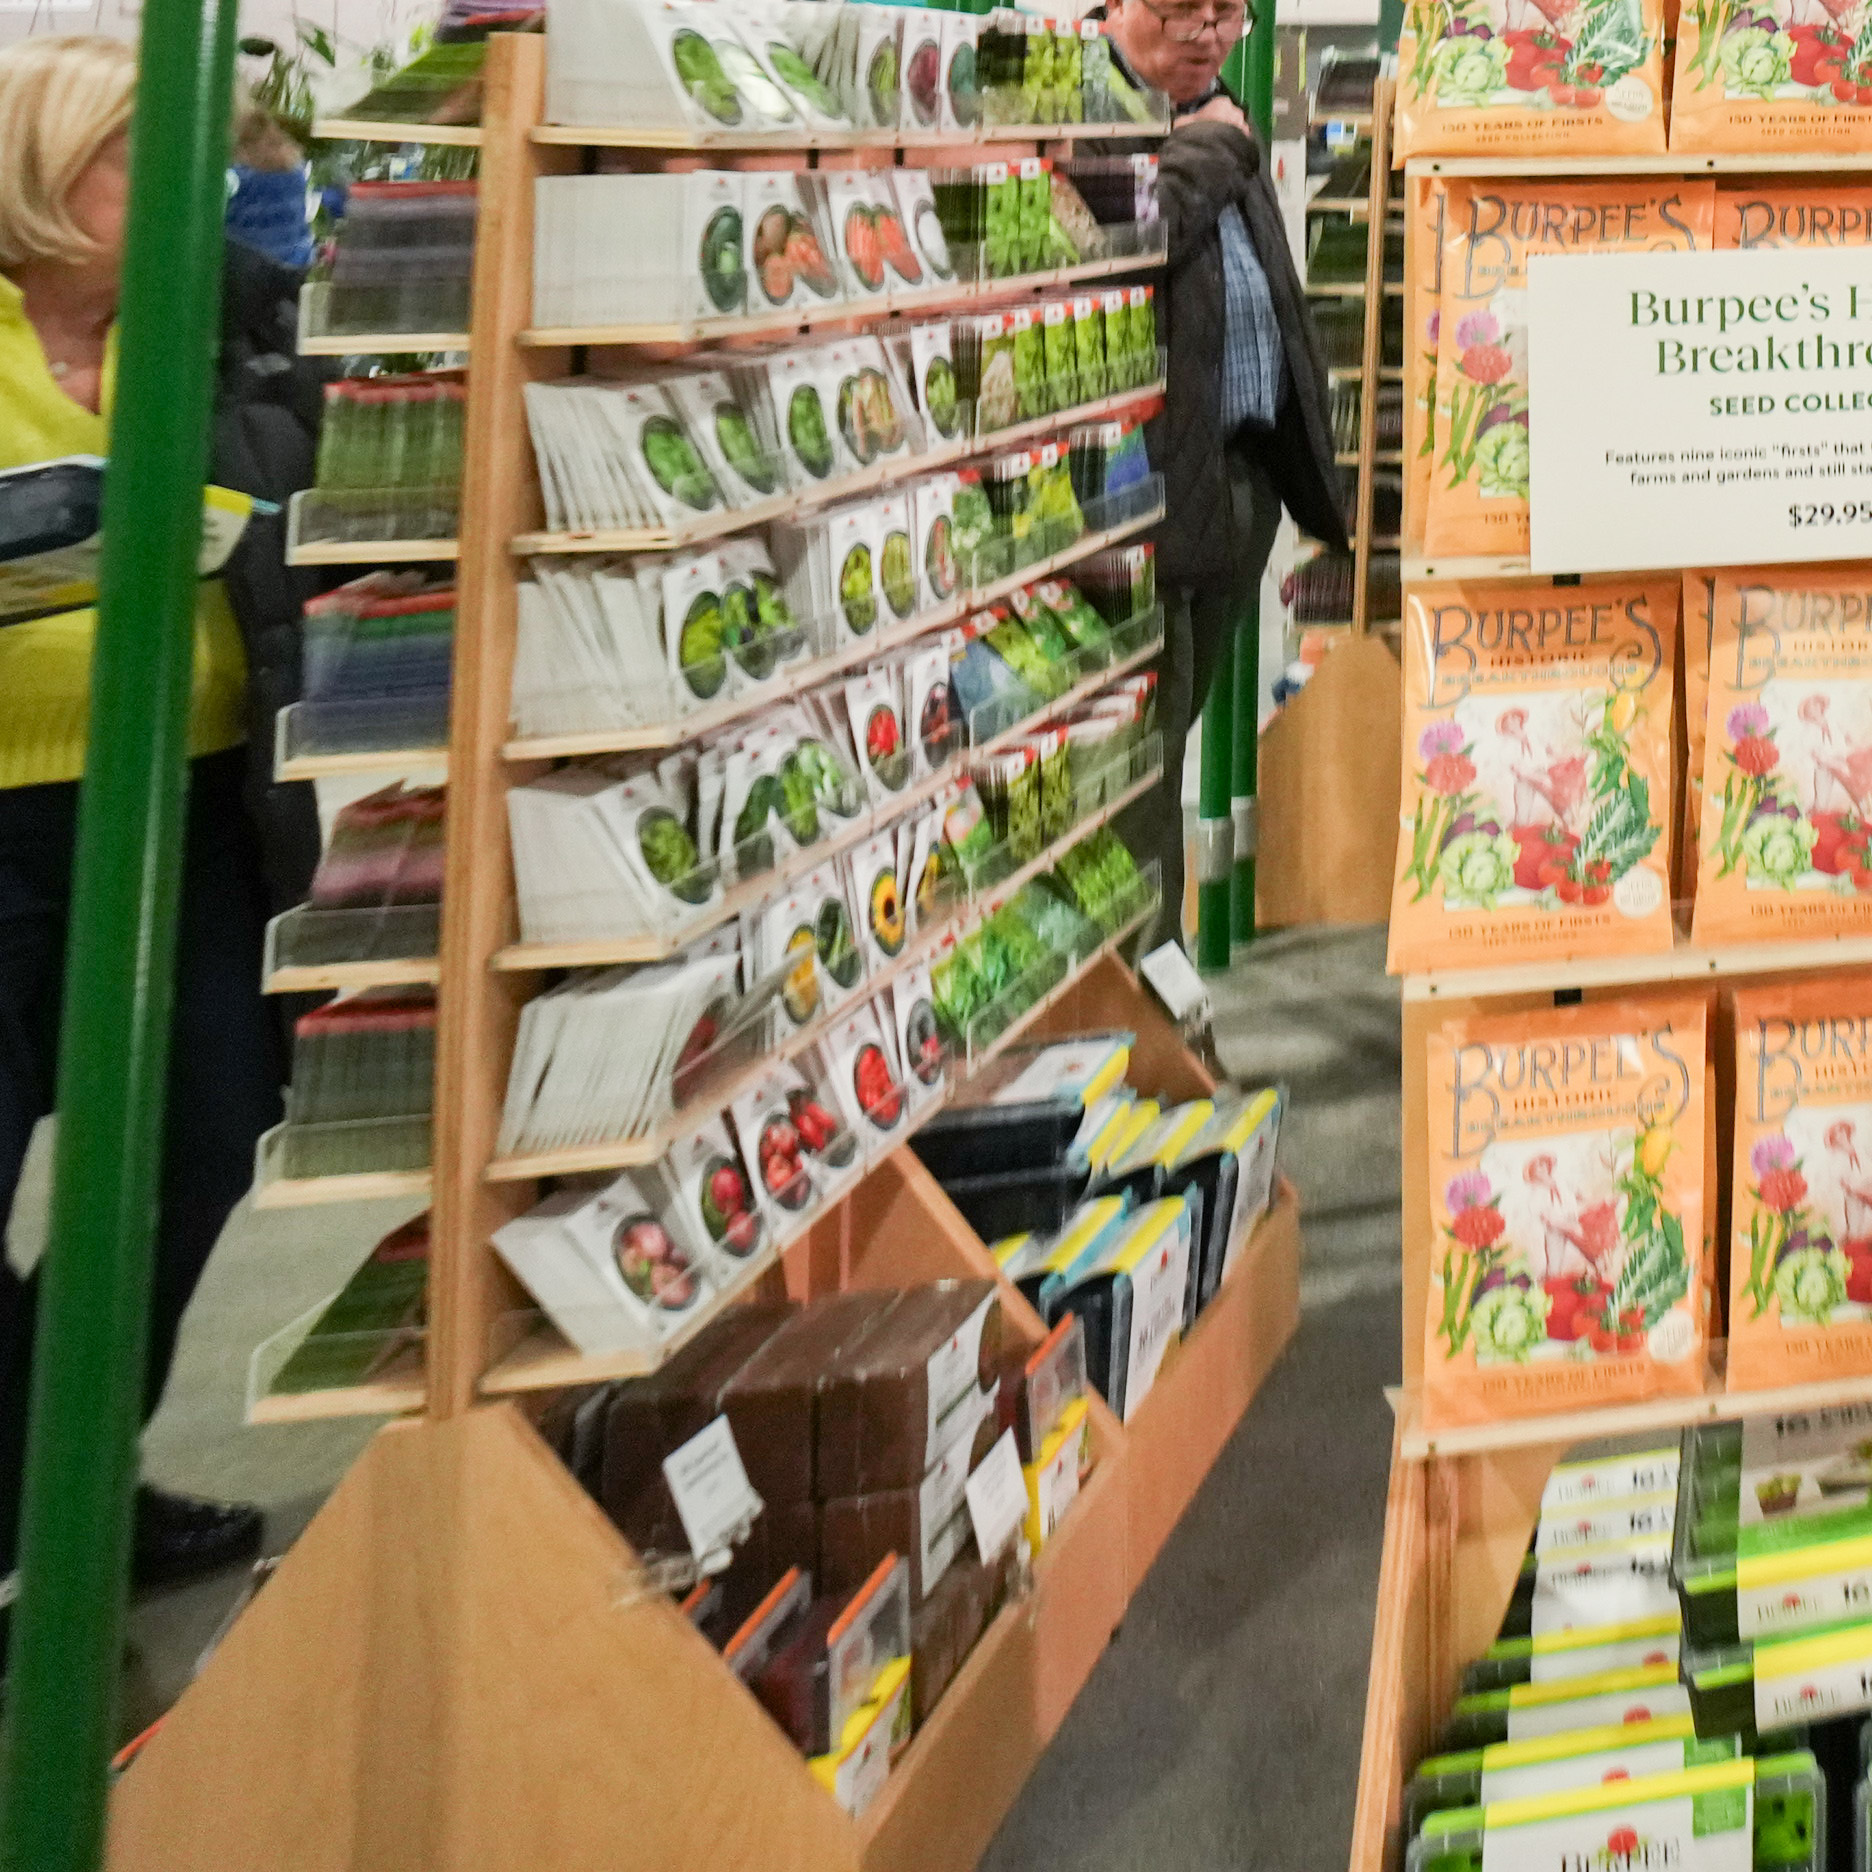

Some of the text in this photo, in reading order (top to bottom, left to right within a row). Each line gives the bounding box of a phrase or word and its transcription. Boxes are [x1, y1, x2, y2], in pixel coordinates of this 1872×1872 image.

[1759, 114, 1806, 125] YEARS
[1454, 193, 1697, 300] BURPEE'S
[1629, 281, 1831, 333] Burpee's
[1709, 395, 1776, 417] SEED
[1605, 449, 1675, 467] Features
[1680, 446, 1714, 463] nine
[1720, 444, 1767, 461] iconic
[1833, 440, 1865, 456] that
[1630, 471, 1676, 487] farms
[1681, 468, 1711, 484] and
[1715, 466, 1780, 486] gardens
[1784, 464, 1813, 480] and
[1819, 461, 1846, 478] still
[1788, 501, 1872, 530] $29.95
[1418, 592, 1662, 710] BURPEE'S
[1442, 1021, 1690, 1159] BURPEE'S
